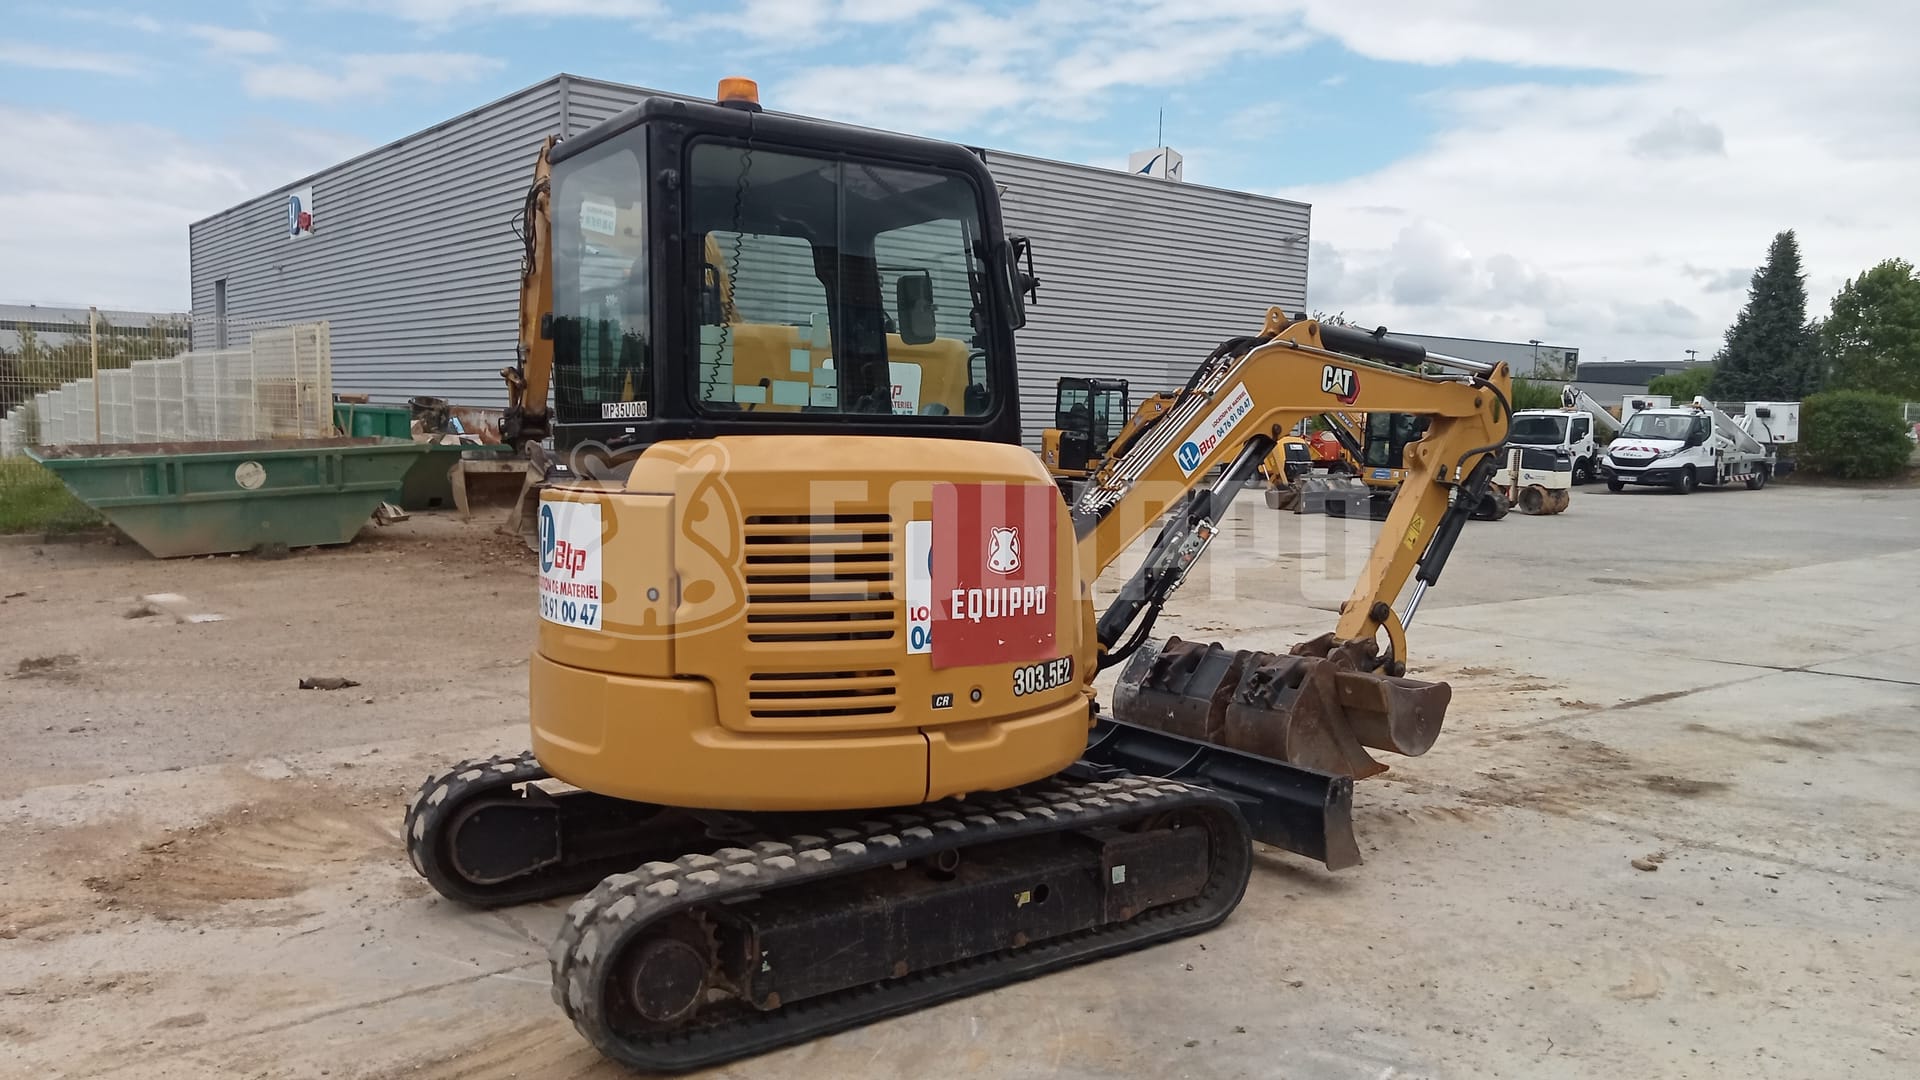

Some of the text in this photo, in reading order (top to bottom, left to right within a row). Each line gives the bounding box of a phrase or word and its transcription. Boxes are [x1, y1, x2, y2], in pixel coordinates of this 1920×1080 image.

[1322, 365, 1353, 396] CAT
[1199, 434, 1217, 456] Btp
[1217, 427, 1225, 437] 04
[1223, 421, 1232, 430] 76
[1230, 413, 1238, 423] 91
[1237, 405, 1244, 415] 00
[1244, 398, 1250, 408] 47
[554, 540, 587, 579] Btp
[552, 579, 559, 594] DE
[559, 581, 599, 599] MATERIEL
[952, 585, 1047, 624] EQUIPPO
[549, 596, 558, 620] 91
[561, 599, 577, 623] 00
[580, 603, 598, 625] 47
[1013, 658, 1072, 696] 303.5E2
[935, 695, 951, 707] CR
